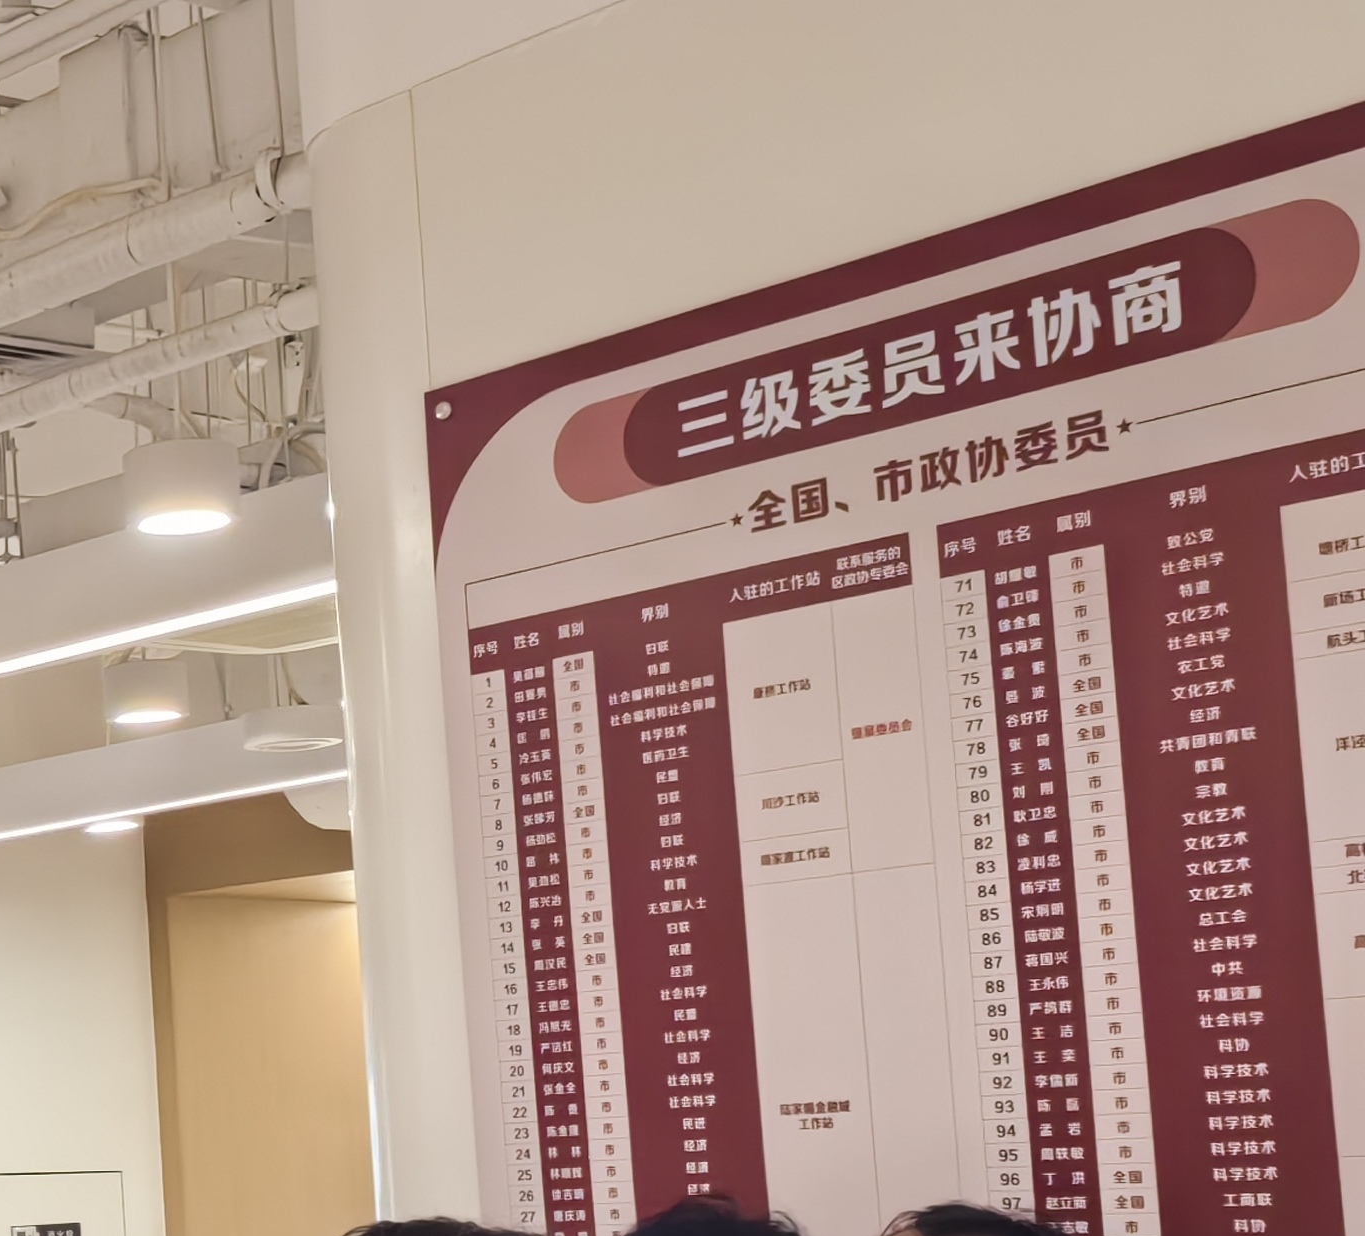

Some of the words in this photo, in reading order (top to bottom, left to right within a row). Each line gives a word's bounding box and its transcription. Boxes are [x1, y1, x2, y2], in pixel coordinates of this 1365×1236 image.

[677, 261, 1183, 457] 三级委员来协商
[748, 410, 1109, 533] 全国、市政协委员
[945, 537, 976, 558] 序号
[997, 526, 1031, 546] 姓名
[1169, 485, 1206, 508] 界别
[836, 546, 901, 571] 联系服务的
[955, 578, 971, 592] 71
[1071, 557, 1083, 570] 市
[1167, 528, 1213, 549] 致公党
[831, 562, 909, 589] 区政协专委会
[955, 602, 974, 616] 72
[1161, 552, 1223, 575] 社会科学
[474, 641, 497, 658] 序号
[514, 632, 539, 649] 姓名
[957, 626, 976, 640] 73
[959, 649, 977, 663] 74
[1165, 602, 1229, 626] 文化艺术
[961, 672, 979, 685] 75
[1167, 628, 1230, 650] 社会科学
[486, 678, 491, 687] 1
[963, 696, 982, 709] 76
[1073, 677, 1101, 692] 全国
[1177, 655, 1225, 674] 农工党
[965, 719, 983, 732] 77
[1075, 700, 1103, 717] 全国
[1171, 678, 1235, 700] 文化艺术
[967, 742, 985, 756] 78
[1077, 725, 1105, 741] 全国
[1190, 706, 1221, 723] 经济
[491, 758, 498, 769] 5
[969, 766, 987, 779] 79
[1087, 752, 1099, 764] 市
[1160, 727, 1256, 753] 共青团和青联
[971, 789, 989, 803] 80
[973, 813, 990, 826] 81
[1195, 783, 1227, 798] 宗教
[495, 820, 502, 830] 8
[975, 836, 993, 850] 82
[1093, 825, 1105, 837] 市
[1182, 806, 1245, 826] 文化艺术
[495, 860, 508, 872] 10
[976, 860, 995, 874] 83
[1184, 832, 1248, 852] 文化艺术
[978, 884, 997, 898] 84
[1186, 857, 1251, 876] 文化艺术
[980, 908, 999, 921] 85
[1189, 883, 1252, 902] 文化艺术
[982, 932, 1001, 946] 86
[1199, 910, 1246, 926] 总工会
[501, 942, 514, 954] 14
[984, 956, 1002, 969] 87
[1193, 934, 1257, 952] 社会科学
[504, 984, 517, 994] 16
[986, 980, 1005, 993] 88
[1105, 972, 1117, 985] 市
[1212, 961, 1243, 976] 中共
[988, 1004, 1006, 1017] 89
[989, 1028, 1008, 1041] 90
[1200, 1012, 1263, 1028] 社会科学
[992, 1052, 1009, 1065] 91
[1111, 1047, 1123, 1059] 市
[1219, 1038, 1249, 1052] 科协
[510, 1065, 524, 1077] 20
[993, 1076, 1012, 1089] 92
[1204, 1063, 1268, 1079] 科学技术
[995, 1100, 1014, 1113] 93
[515, 1128, 529, 1139] 23
[799, 1117, 834, 1131] 工作站
[997, 1125, 1015, 1138] 94
[1209, 1114, 1273, 1130] 科学技术
[999, 1149, 1017, 1162] 95
[1001, 1173, 1020, 1186] 96
[1113, 1171, 1142, 1184] 全国
[1213, 1166, 1278, 1181] 科学技术
[519, 1190, 533, 1202] 26
[1000, 1197, 1023, 1212] 97
[1115, 1195, 1144, 1209] 全国
[1224, 1193, 1272, 1206] 工商联
[521, 1211, 535, 1223] 27
[1234, 1219, 1266, 1232] 科协
